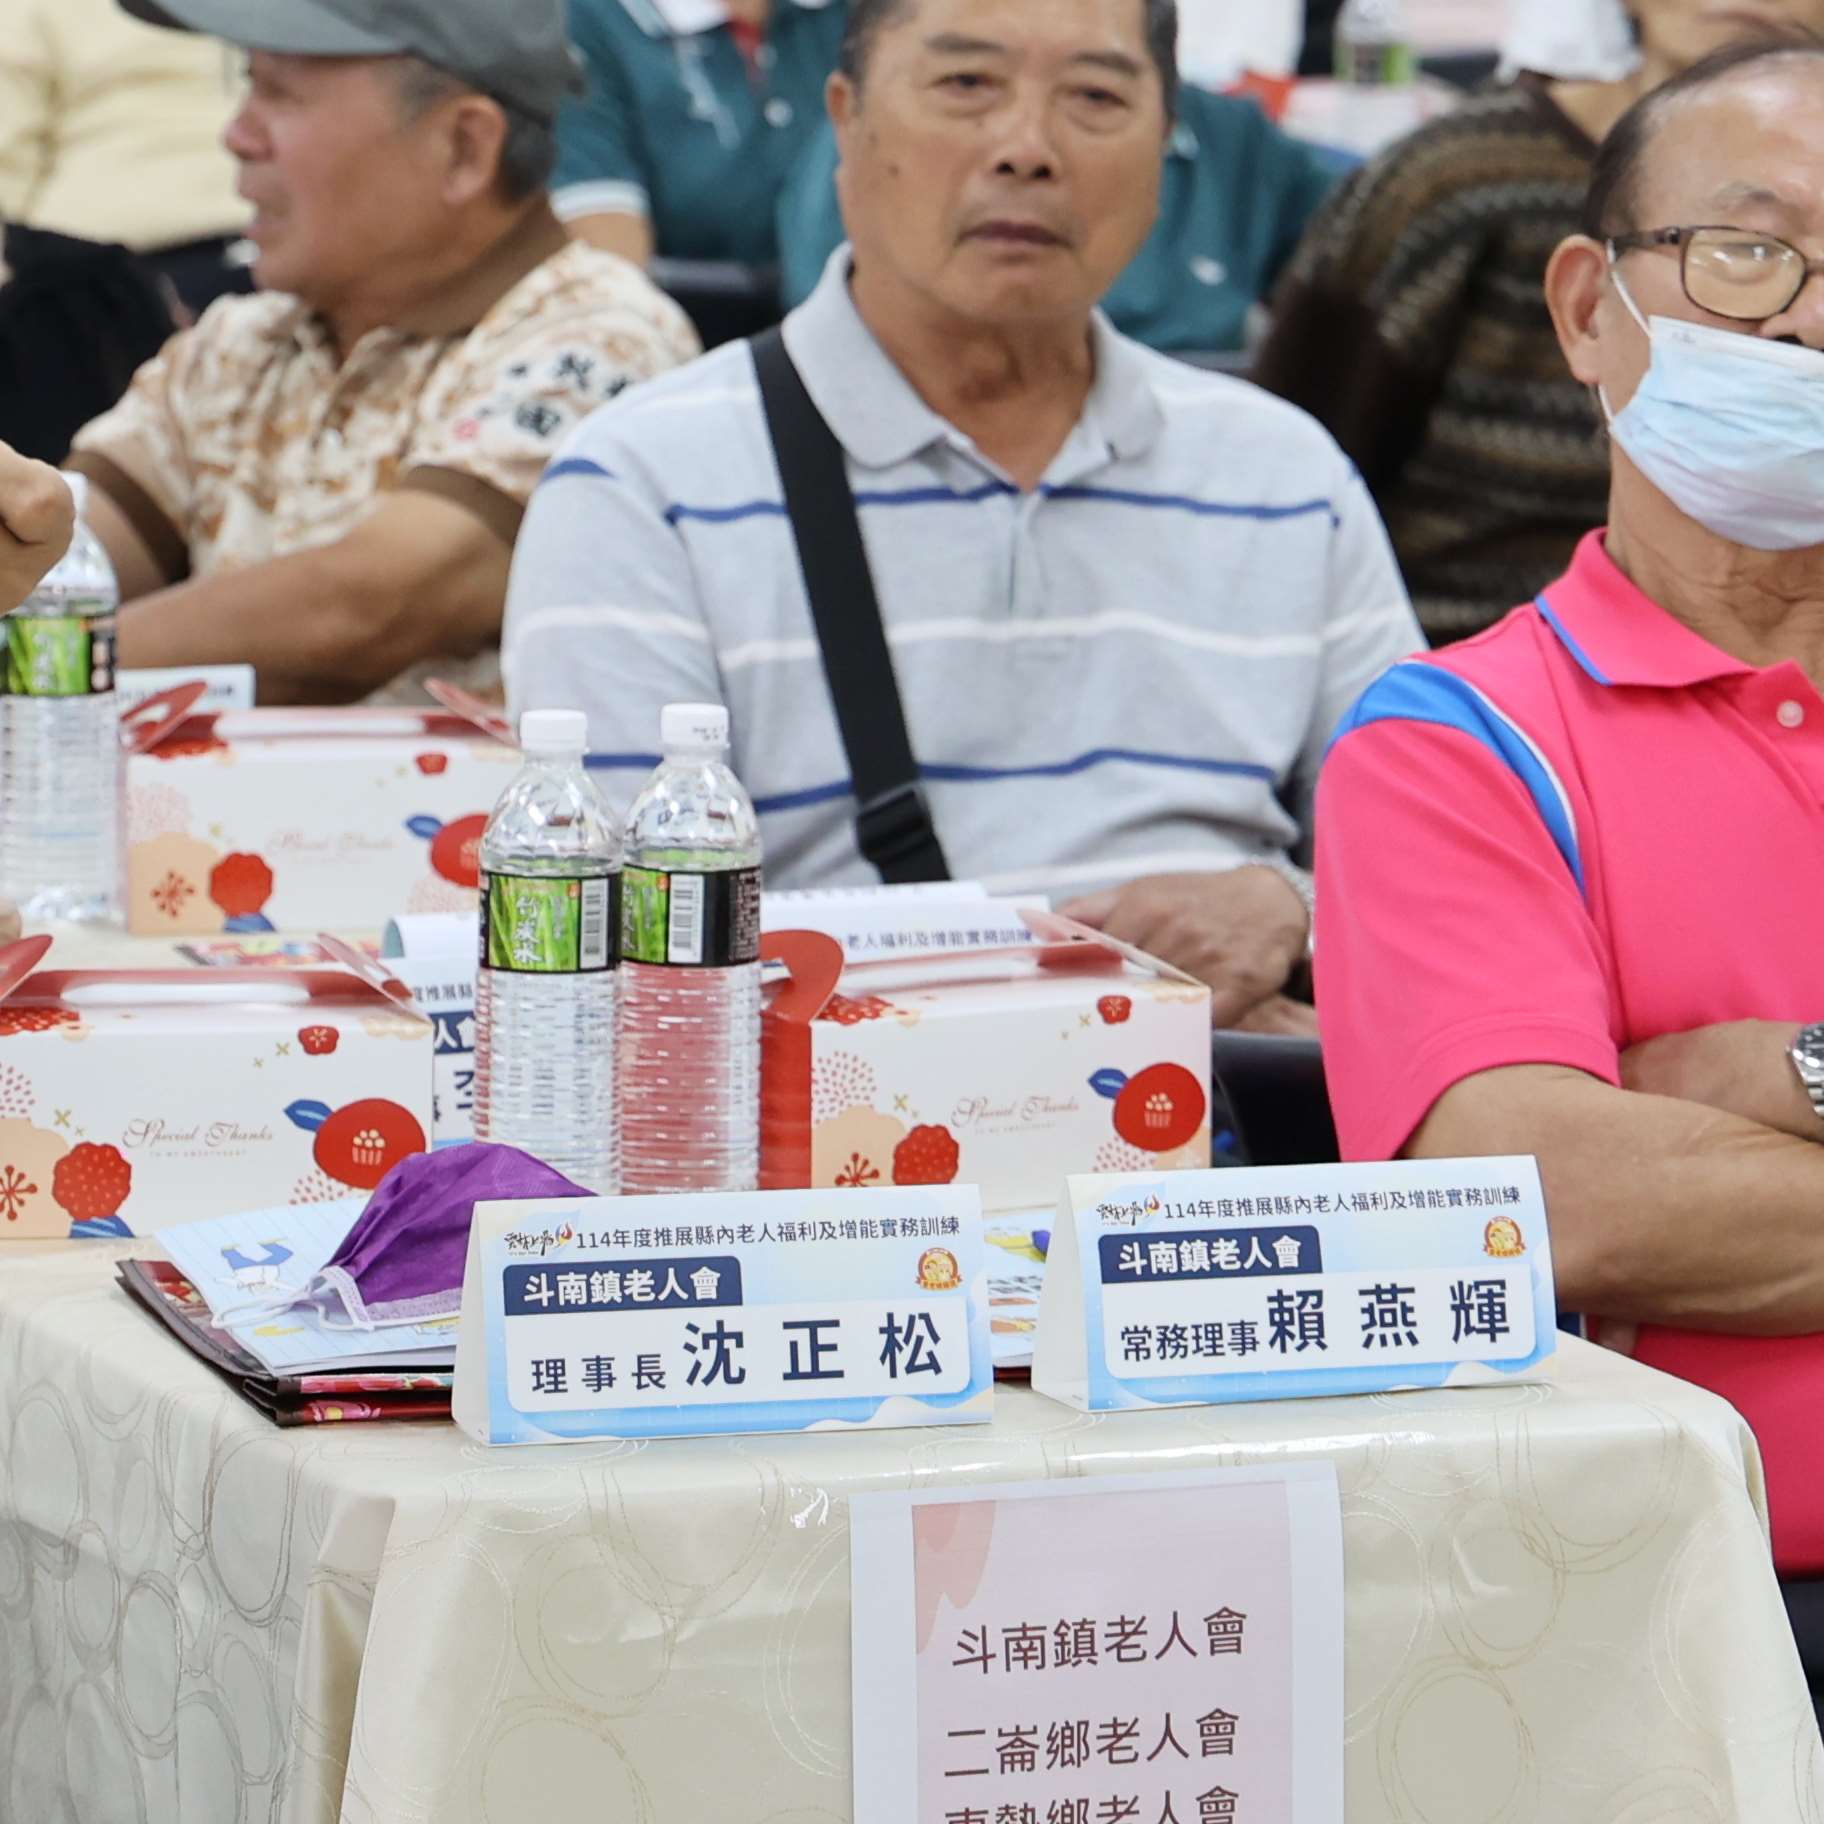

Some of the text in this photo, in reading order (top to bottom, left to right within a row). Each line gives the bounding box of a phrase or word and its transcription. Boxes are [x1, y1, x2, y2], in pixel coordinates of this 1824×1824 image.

[122, 1118, 273, 1148] Special Thanks
[1165, 1185, 1521, 1220] 114年度推展縣內老人福利及增能實務訓練
[576, 1216, 961, 1251] 114年度推展縣內老人福利及增能實務訓練
[1119, 1235, 1302, 1275] 斗南鎮老人會
[523, 1266, 721, 1306] 斗南鎮老人會
[1122, 1278, 1510, 1361] 常務理事 賴燕輝
[685, 1312, 942, 1386] 沈正松
[952, 1606, 1248, 1675] 斗南鎮老人會
[944, 1708, 1240, 1778] 二崙鄉老人會
